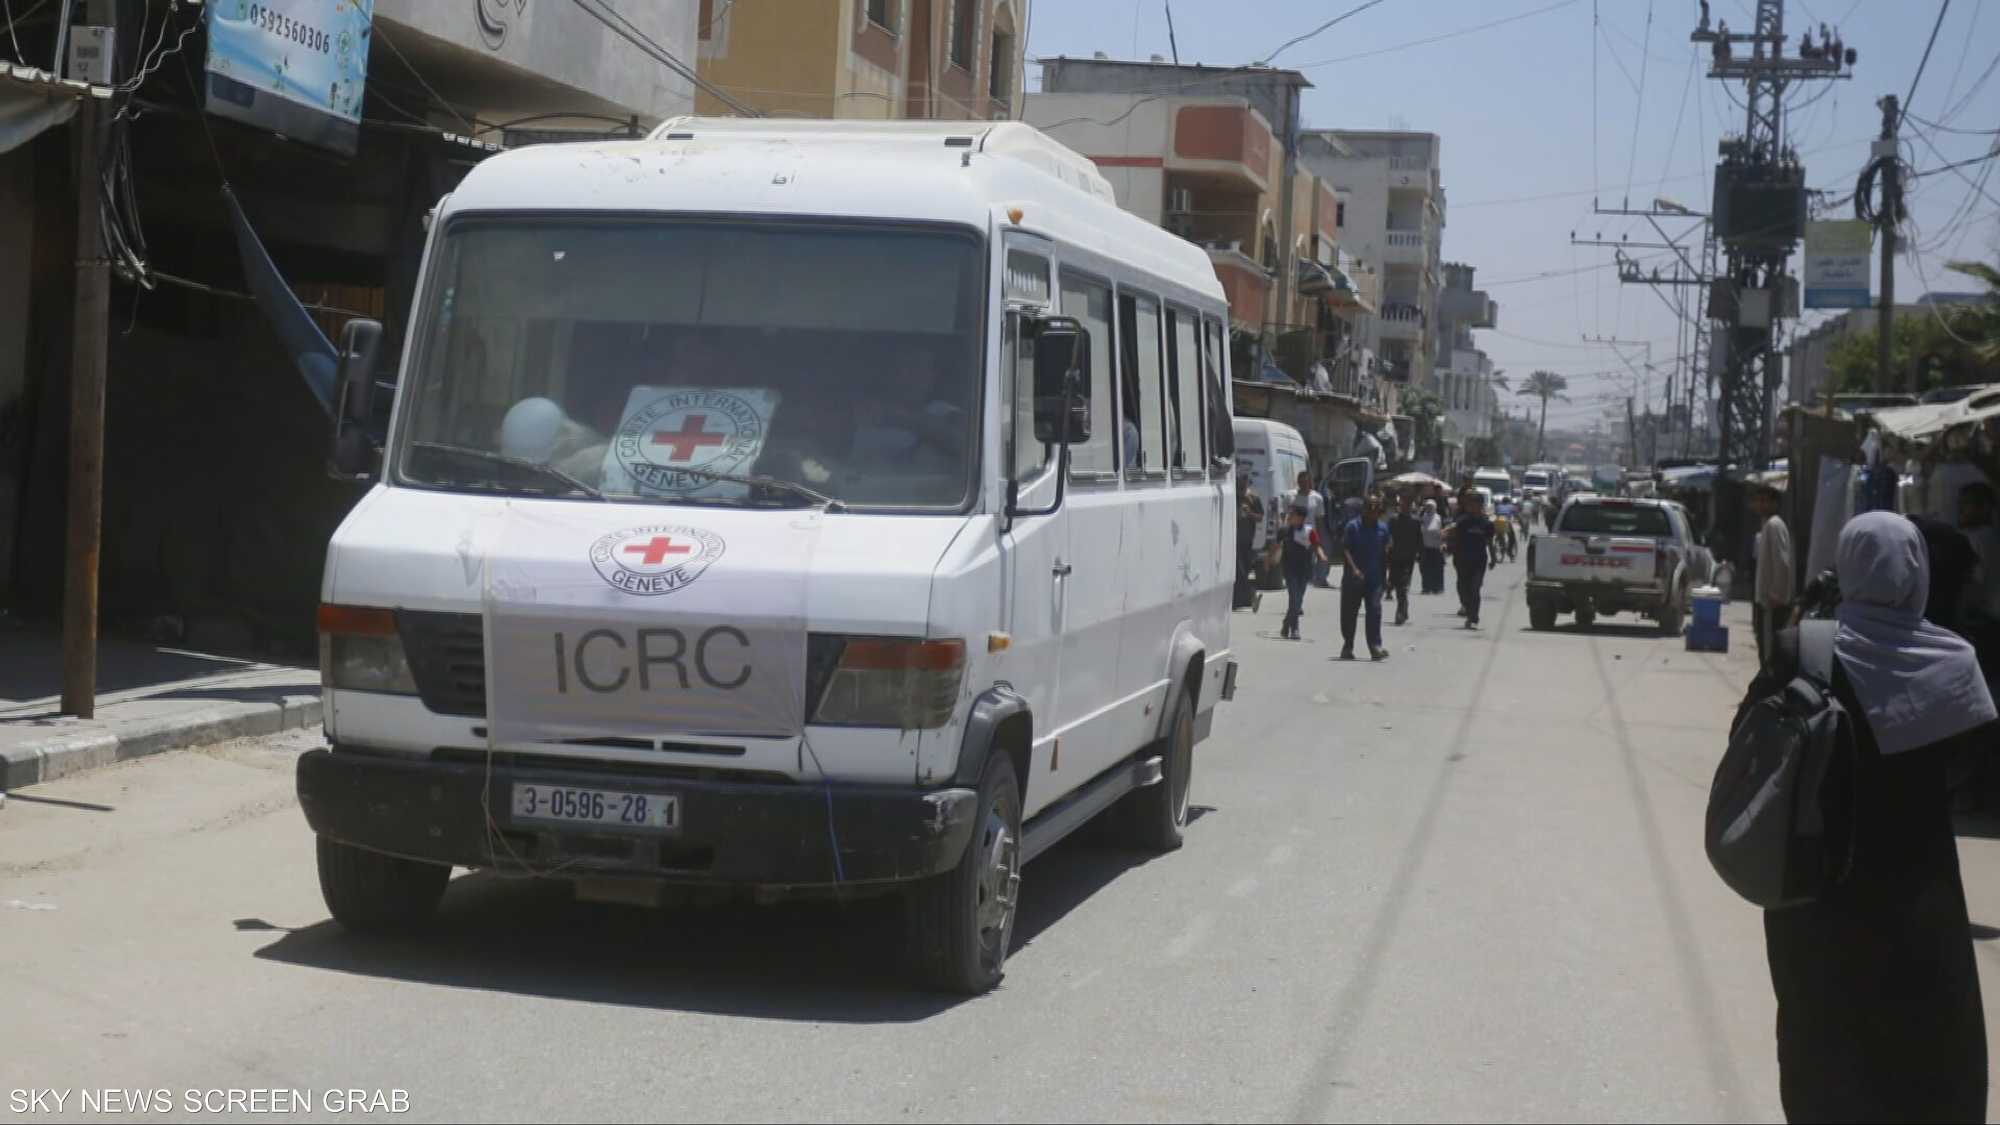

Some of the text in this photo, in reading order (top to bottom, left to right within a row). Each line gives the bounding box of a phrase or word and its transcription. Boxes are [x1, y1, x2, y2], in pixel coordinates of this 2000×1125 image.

[250, 3, 330, 55] 0592560306
[611, 568, 690, 592] GENEVE
[554, 625, 752, 693] ICRC
[524, 786, 648, 823] 3-0596-28
